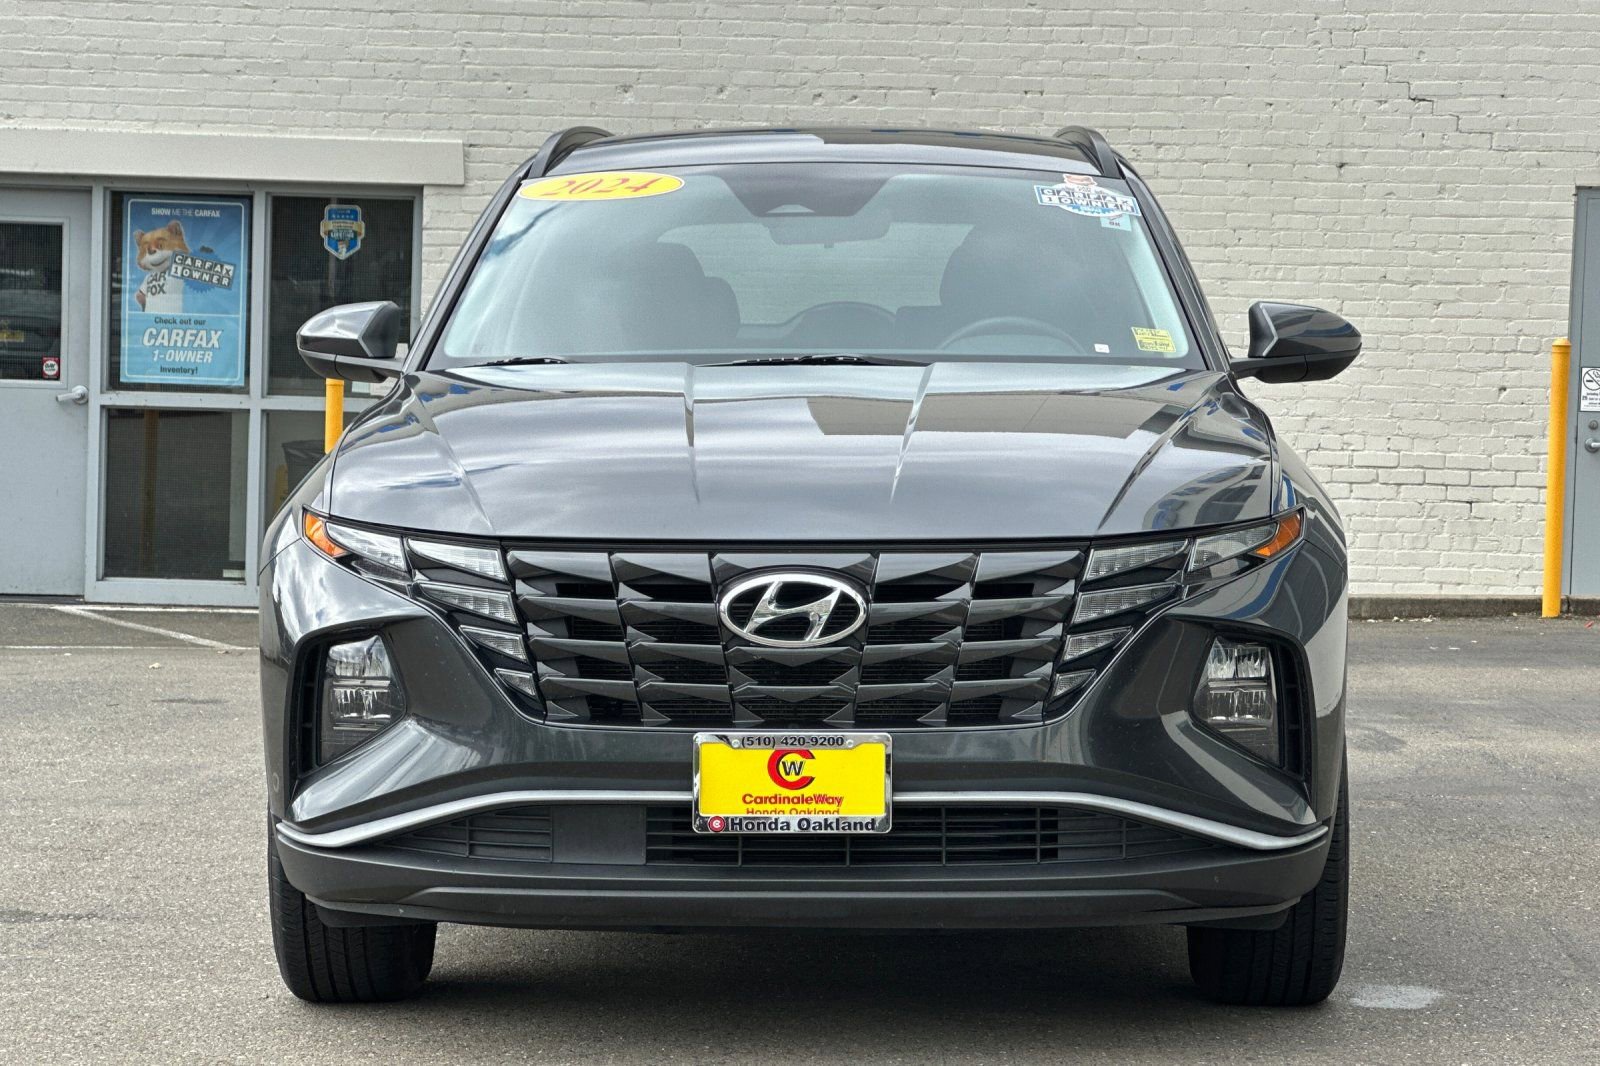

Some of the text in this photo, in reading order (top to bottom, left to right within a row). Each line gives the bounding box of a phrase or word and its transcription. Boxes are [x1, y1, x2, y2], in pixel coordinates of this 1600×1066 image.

[540, 178, 663, 197] 2024
[151, 207, 171, 216] SHOW
[194, 209, 221, 218] CARFAX
[175, 255, 232, 276] CARFAX
[147, 271, 167, 285] CAR
[173, 265, 230, 287] 1 OWNER
[154, 316, 177, 325] Check
[143, 327, 222, 349] CARFAX
[153, 349, 213, 363] 1-OWNER
[160, 365, 199, 375] Inventory!
[741, 736, 845, 748] (510) 420-9200
[742, 793, 844, 807] CardinaleWay
[730, 817, 876, 831] Honda Oakland
